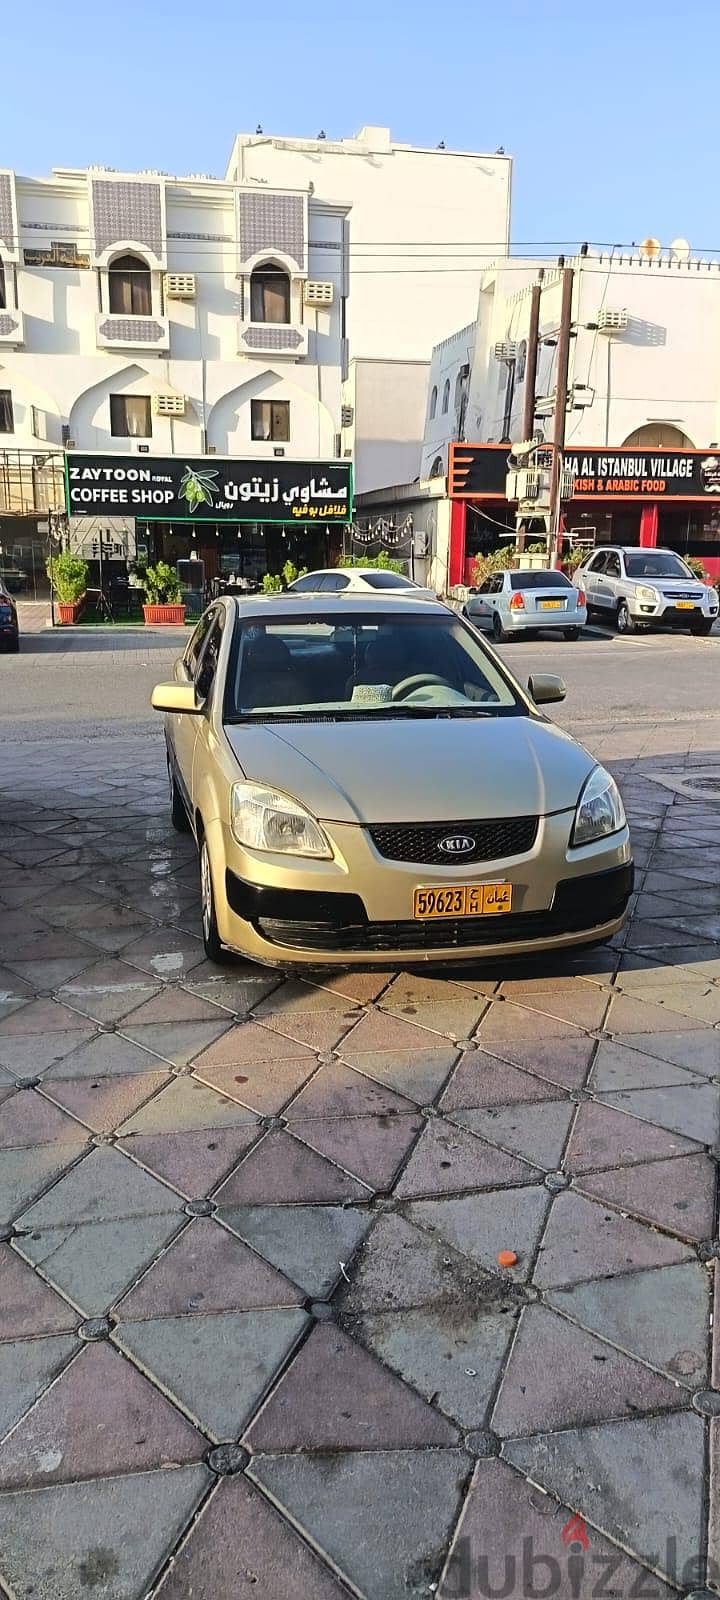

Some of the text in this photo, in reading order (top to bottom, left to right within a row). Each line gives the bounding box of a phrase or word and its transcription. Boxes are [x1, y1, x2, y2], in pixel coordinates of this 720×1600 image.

[69, 467, 151, 481] ZAYTOON
[564, 456, 579, 476] HA
[581, 457, 595, 476] AL
[598, 457, 647, 477] ISTANBUL
[651, 458, 693, 478] VILLAGE
[224, 477, 347, 505] مشاوي زيتون
[572, 478, 666, 492] KISH & ARABIC FOOD
[70, 487, 174, 504] COFFEE SHOP
[319, 504, 347, 517] فلافل
[446, 839, 470, 850] KIA
[418, 890, 463, 914] 59623
[470, 903, 478, 912] H
